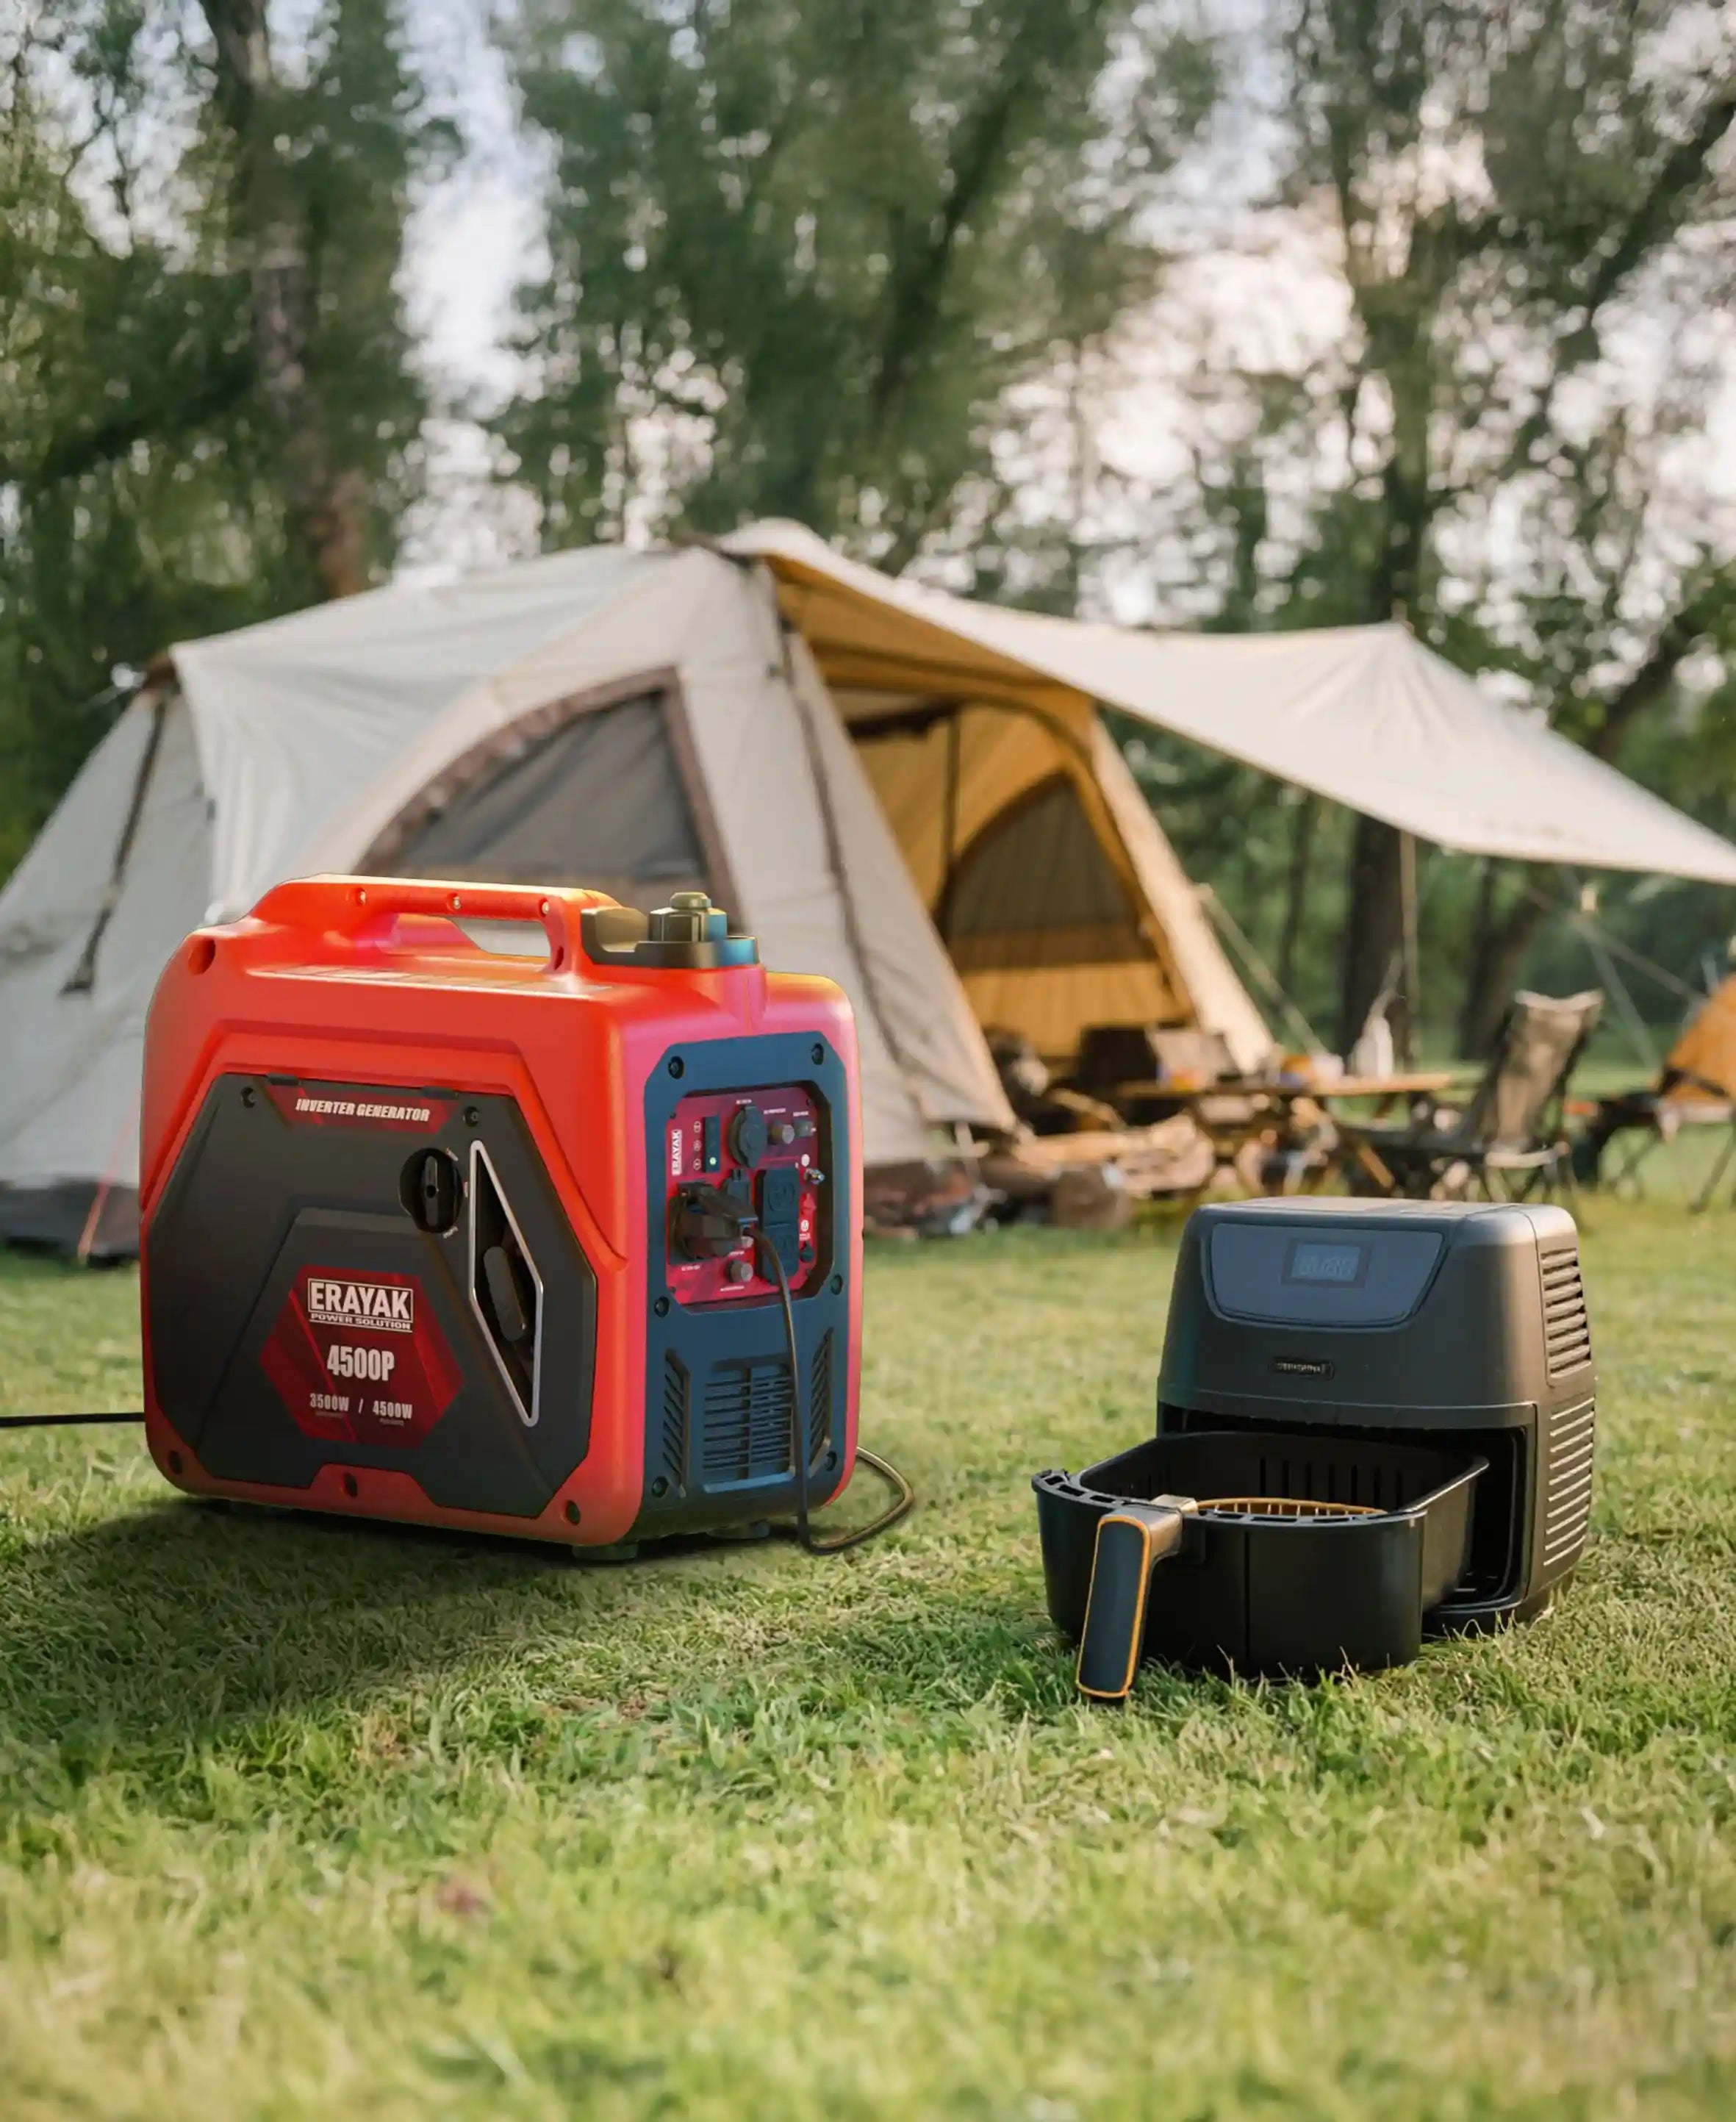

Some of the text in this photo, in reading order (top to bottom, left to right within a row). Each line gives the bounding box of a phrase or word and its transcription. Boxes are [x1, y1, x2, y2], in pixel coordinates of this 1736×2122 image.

[295, 1099, 431, 1122] INVERTER GENERATOR
[310, 1282, 409, 1319] ERAYAK
[311, 1313, 411, 1330] POWER SOLUTION
[326, 1344, 395, 1381] 4500P
[309, 1393, 413, 1419] 3500W / 4500W
